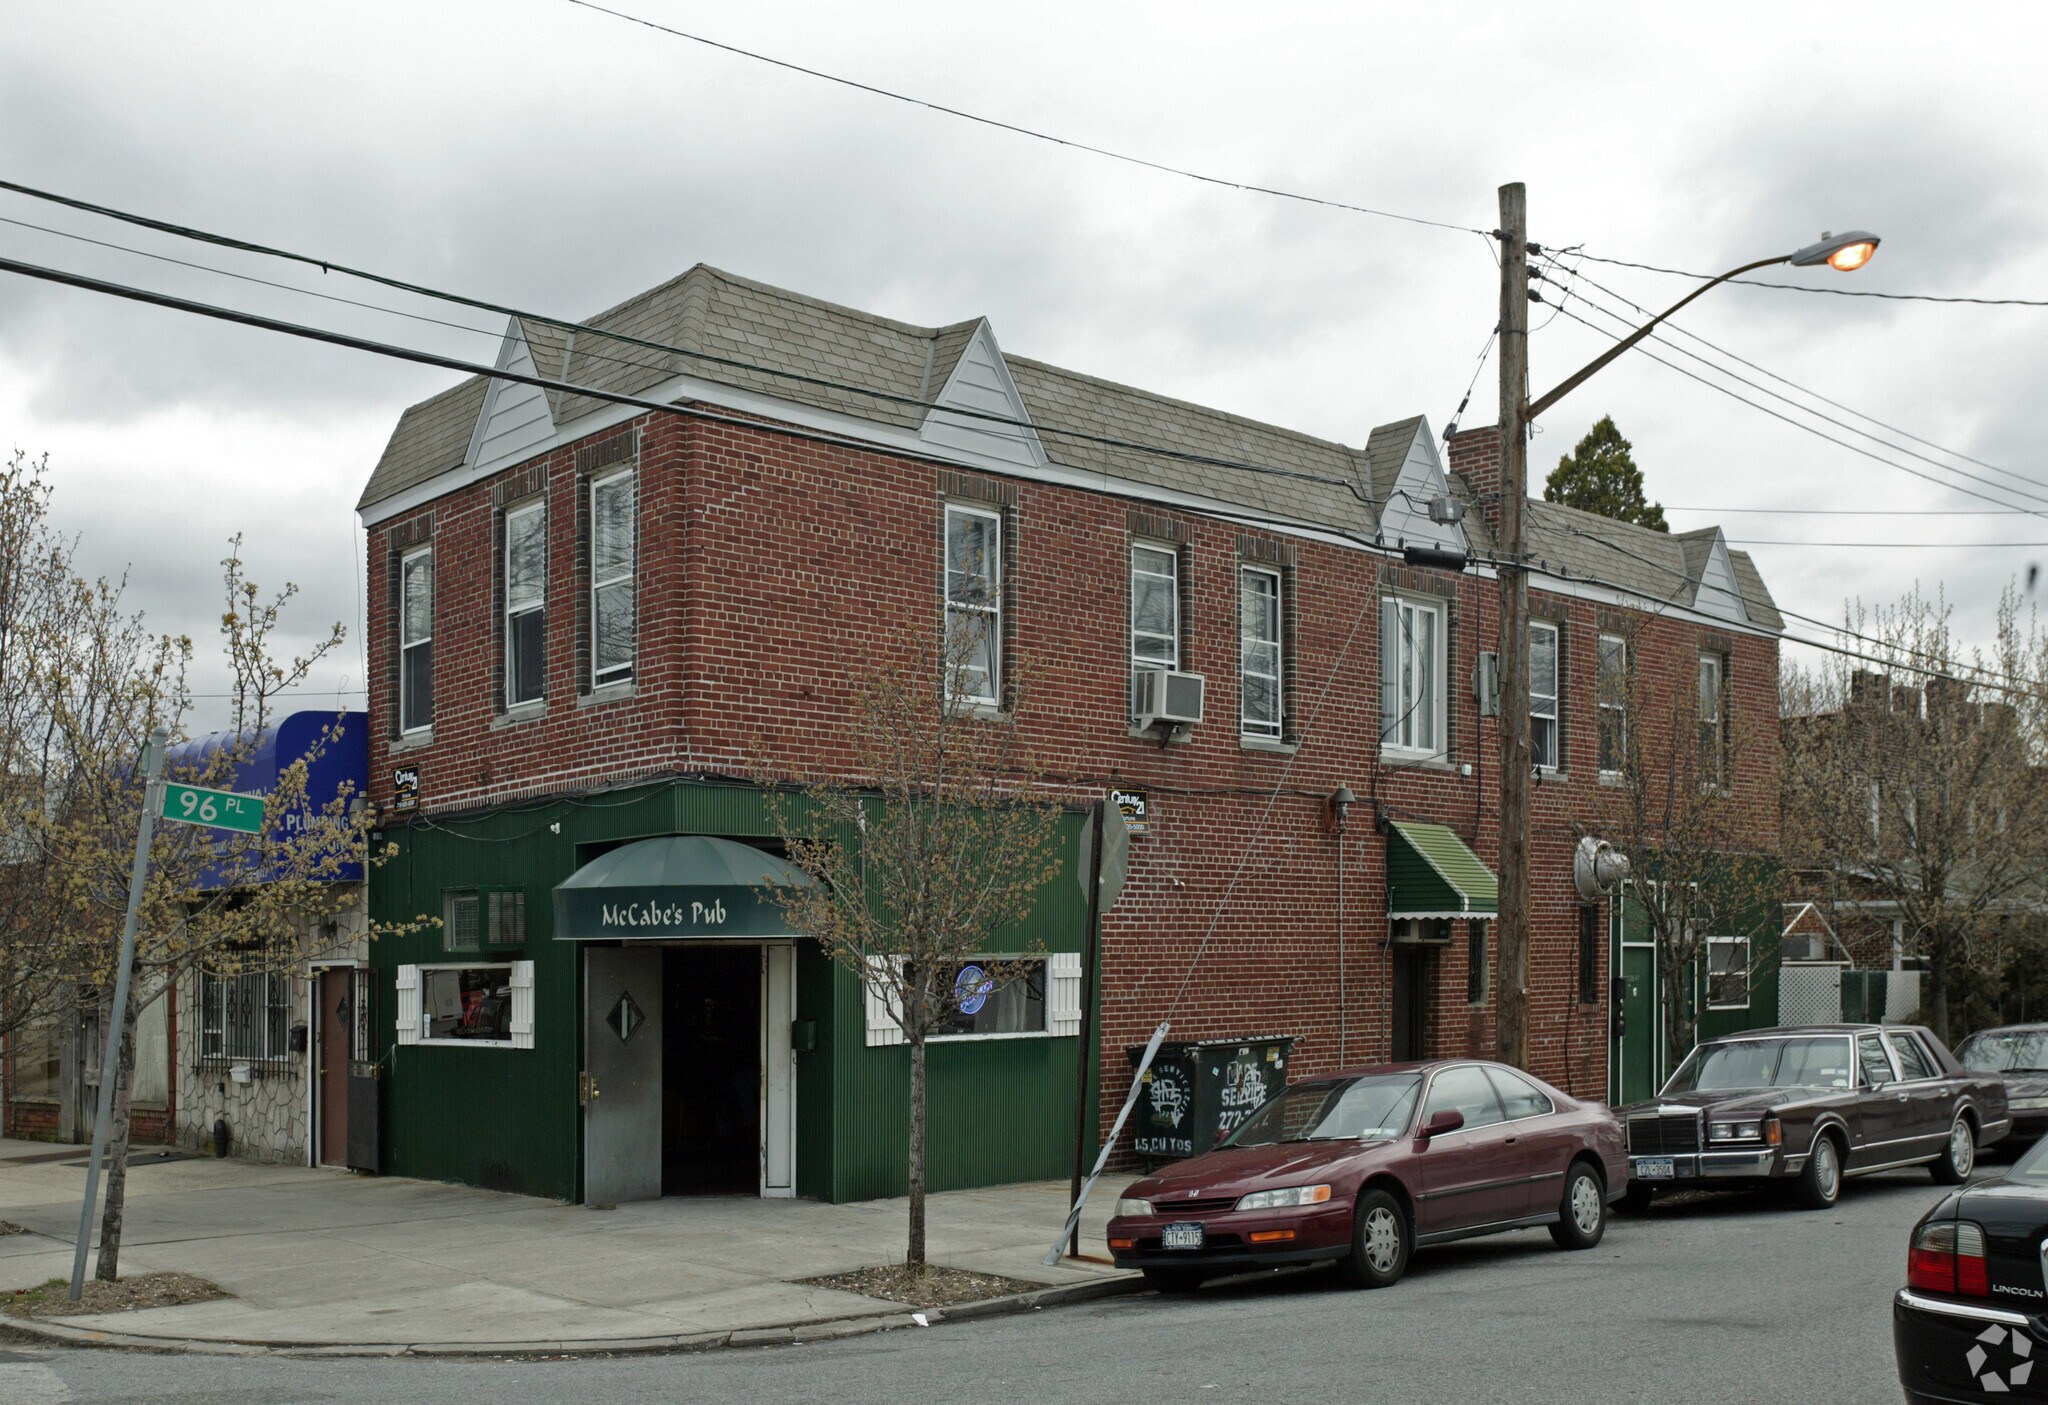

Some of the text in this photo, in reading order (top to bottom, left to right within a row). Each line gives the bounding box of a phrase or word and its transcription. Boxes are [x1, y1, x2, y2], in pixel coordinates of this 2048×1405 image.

[180, 791, 245, 821] 96 PL
[1111, 791, 1139, 806] Century
[1136, 801, 1145, 814] 21
[286, 814, 349, 831] PLUMNG
[602, 898, 727, 926] McCabe's Pub
[1992, 1284, 2044, 1298] LINCOLN
